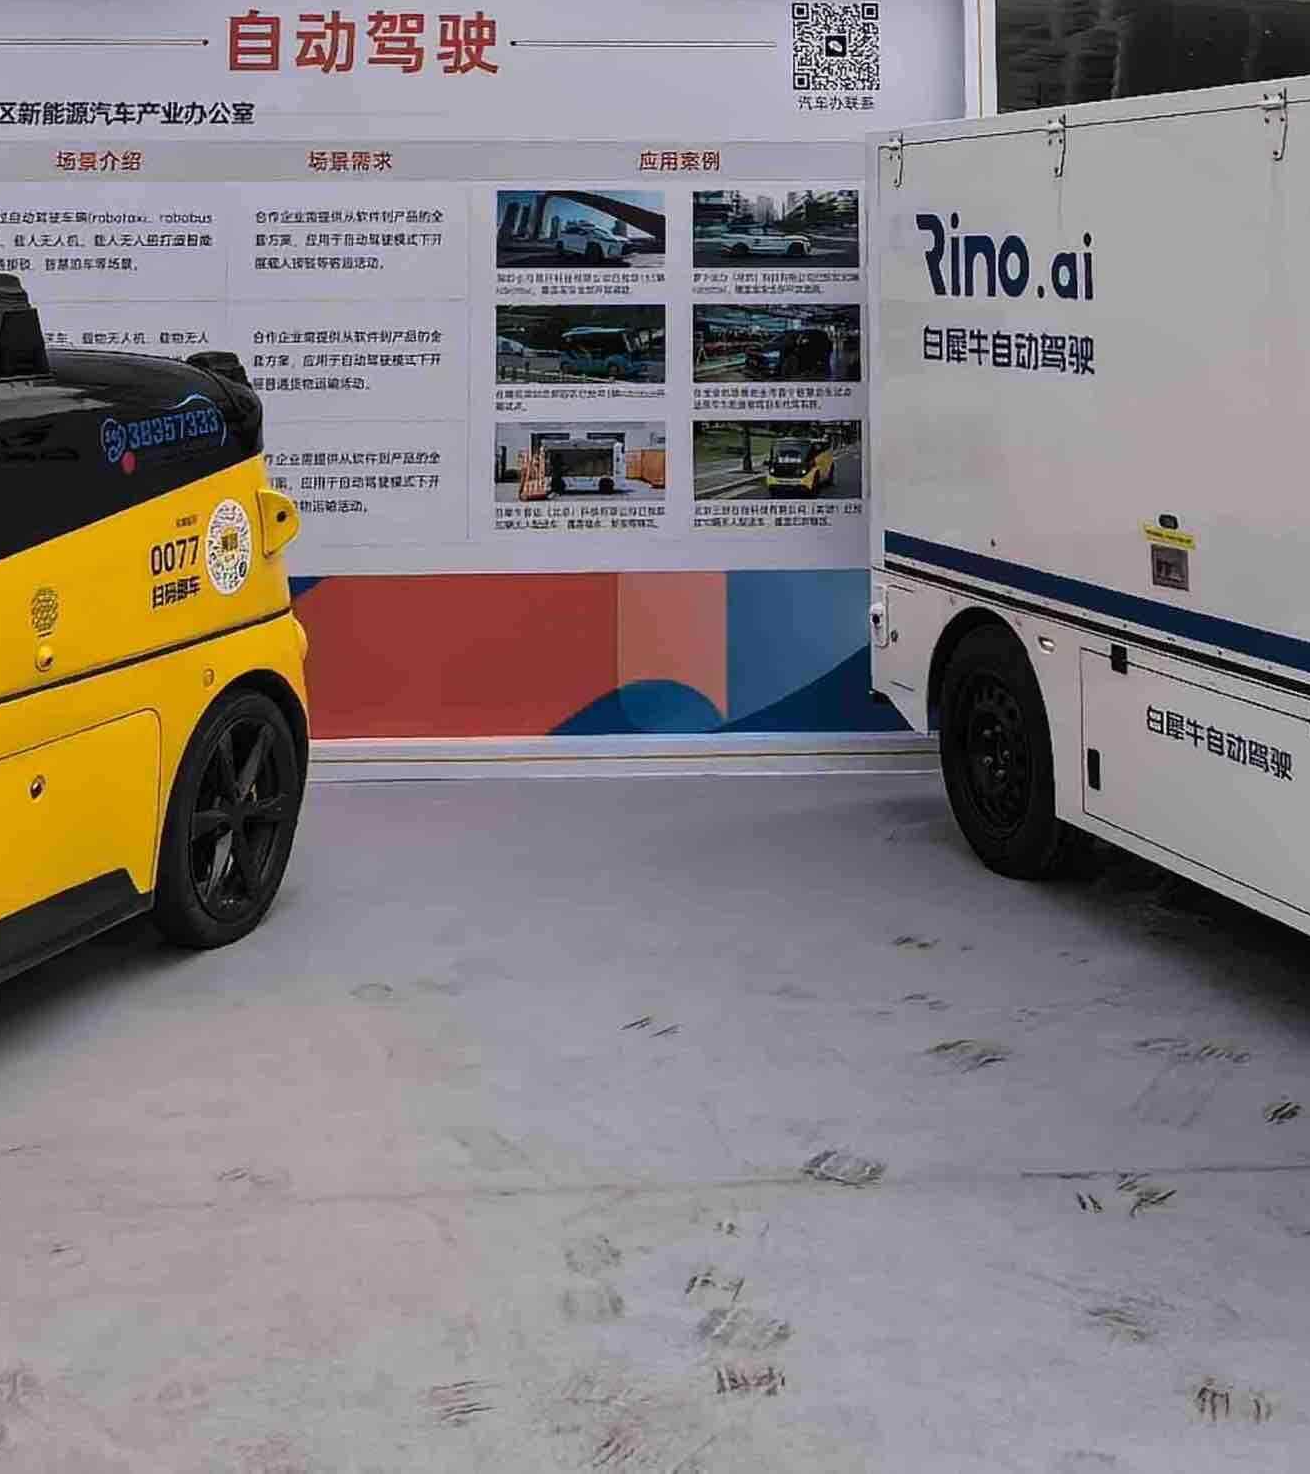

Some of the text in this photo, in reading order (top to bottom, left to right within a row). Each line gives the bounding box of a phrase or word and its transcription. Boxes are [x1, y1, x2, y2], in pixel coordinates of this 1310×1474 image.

[228, 9, 499, 74] 自动驾驶
[56, 152, 143, 171] 场景介绍
[307, 150, 393, 172] 场景需求
[639, 151, 721, 172] 应用案例
[915, 212, 1094, 300] Rino.ai
[922, 326, 1096, 375] 白犀牛自动驾驶
[151, 535, 199, 577] 0077
[1145, 704, 1295, 782] 白犀牛自动驾驶
